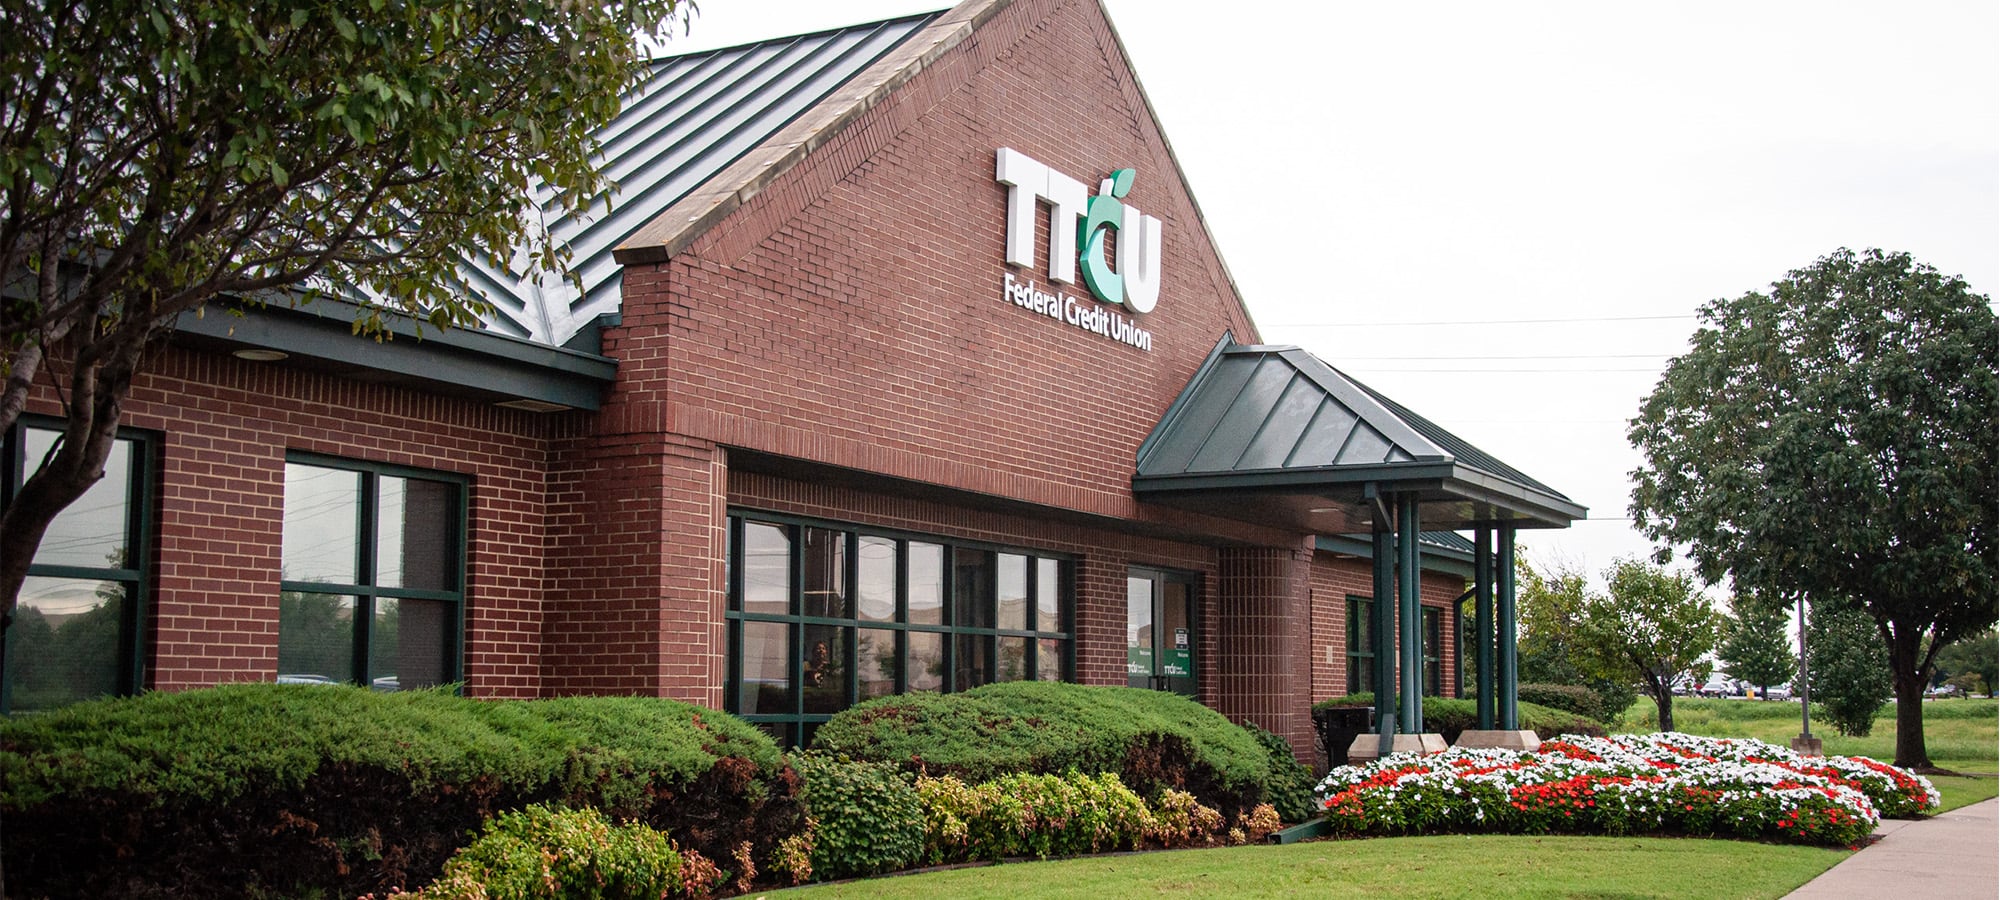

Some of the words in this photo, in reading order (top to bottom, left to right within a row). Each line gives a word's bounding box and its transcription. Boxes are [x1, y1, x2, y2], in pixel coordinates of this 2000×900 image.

[996, 146, 1162, 314] TTCU
[1004, 272, 1063, 321] Federal
[1065, 296, 1110, 337] Credit
[1111, 312, 1151, 352] Union
